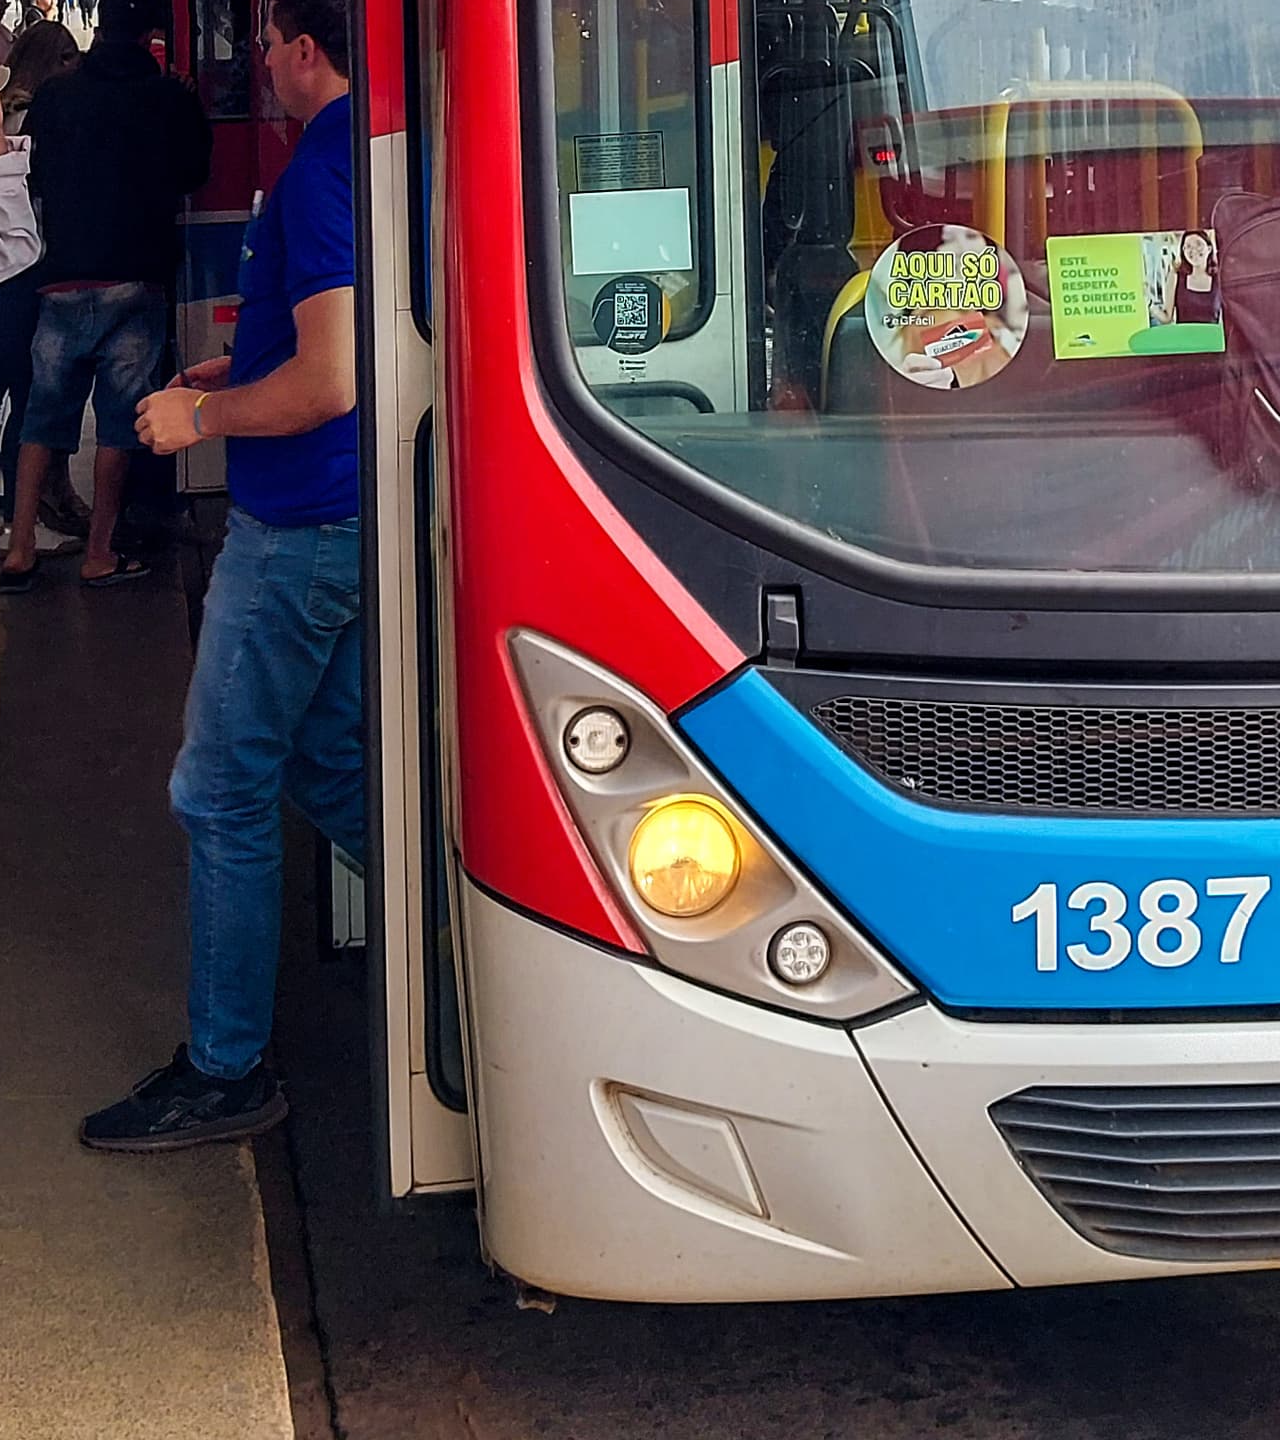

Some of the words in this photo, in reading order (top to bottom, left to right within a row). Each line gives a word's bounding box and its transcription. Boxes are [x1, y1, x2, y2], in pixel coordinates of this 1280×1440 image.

[890, 251, 955, 280] AQUI
[961, 246, 999, 280] SÓ
[1059, 256, 1087, 266] ESTE
[1060, 267, 1119, 278] COLETIVO
[1062, 280, 1118, 291] RESPEITA
[887, 276, 1003, 310] CARTÃO
[1063, 294, 1079, 304] OS
[1082, 291, 1136, 303] DIREITOS
[1063, 306, 1082, 316] DA
[1011, 875, 1272, 973] 1387
